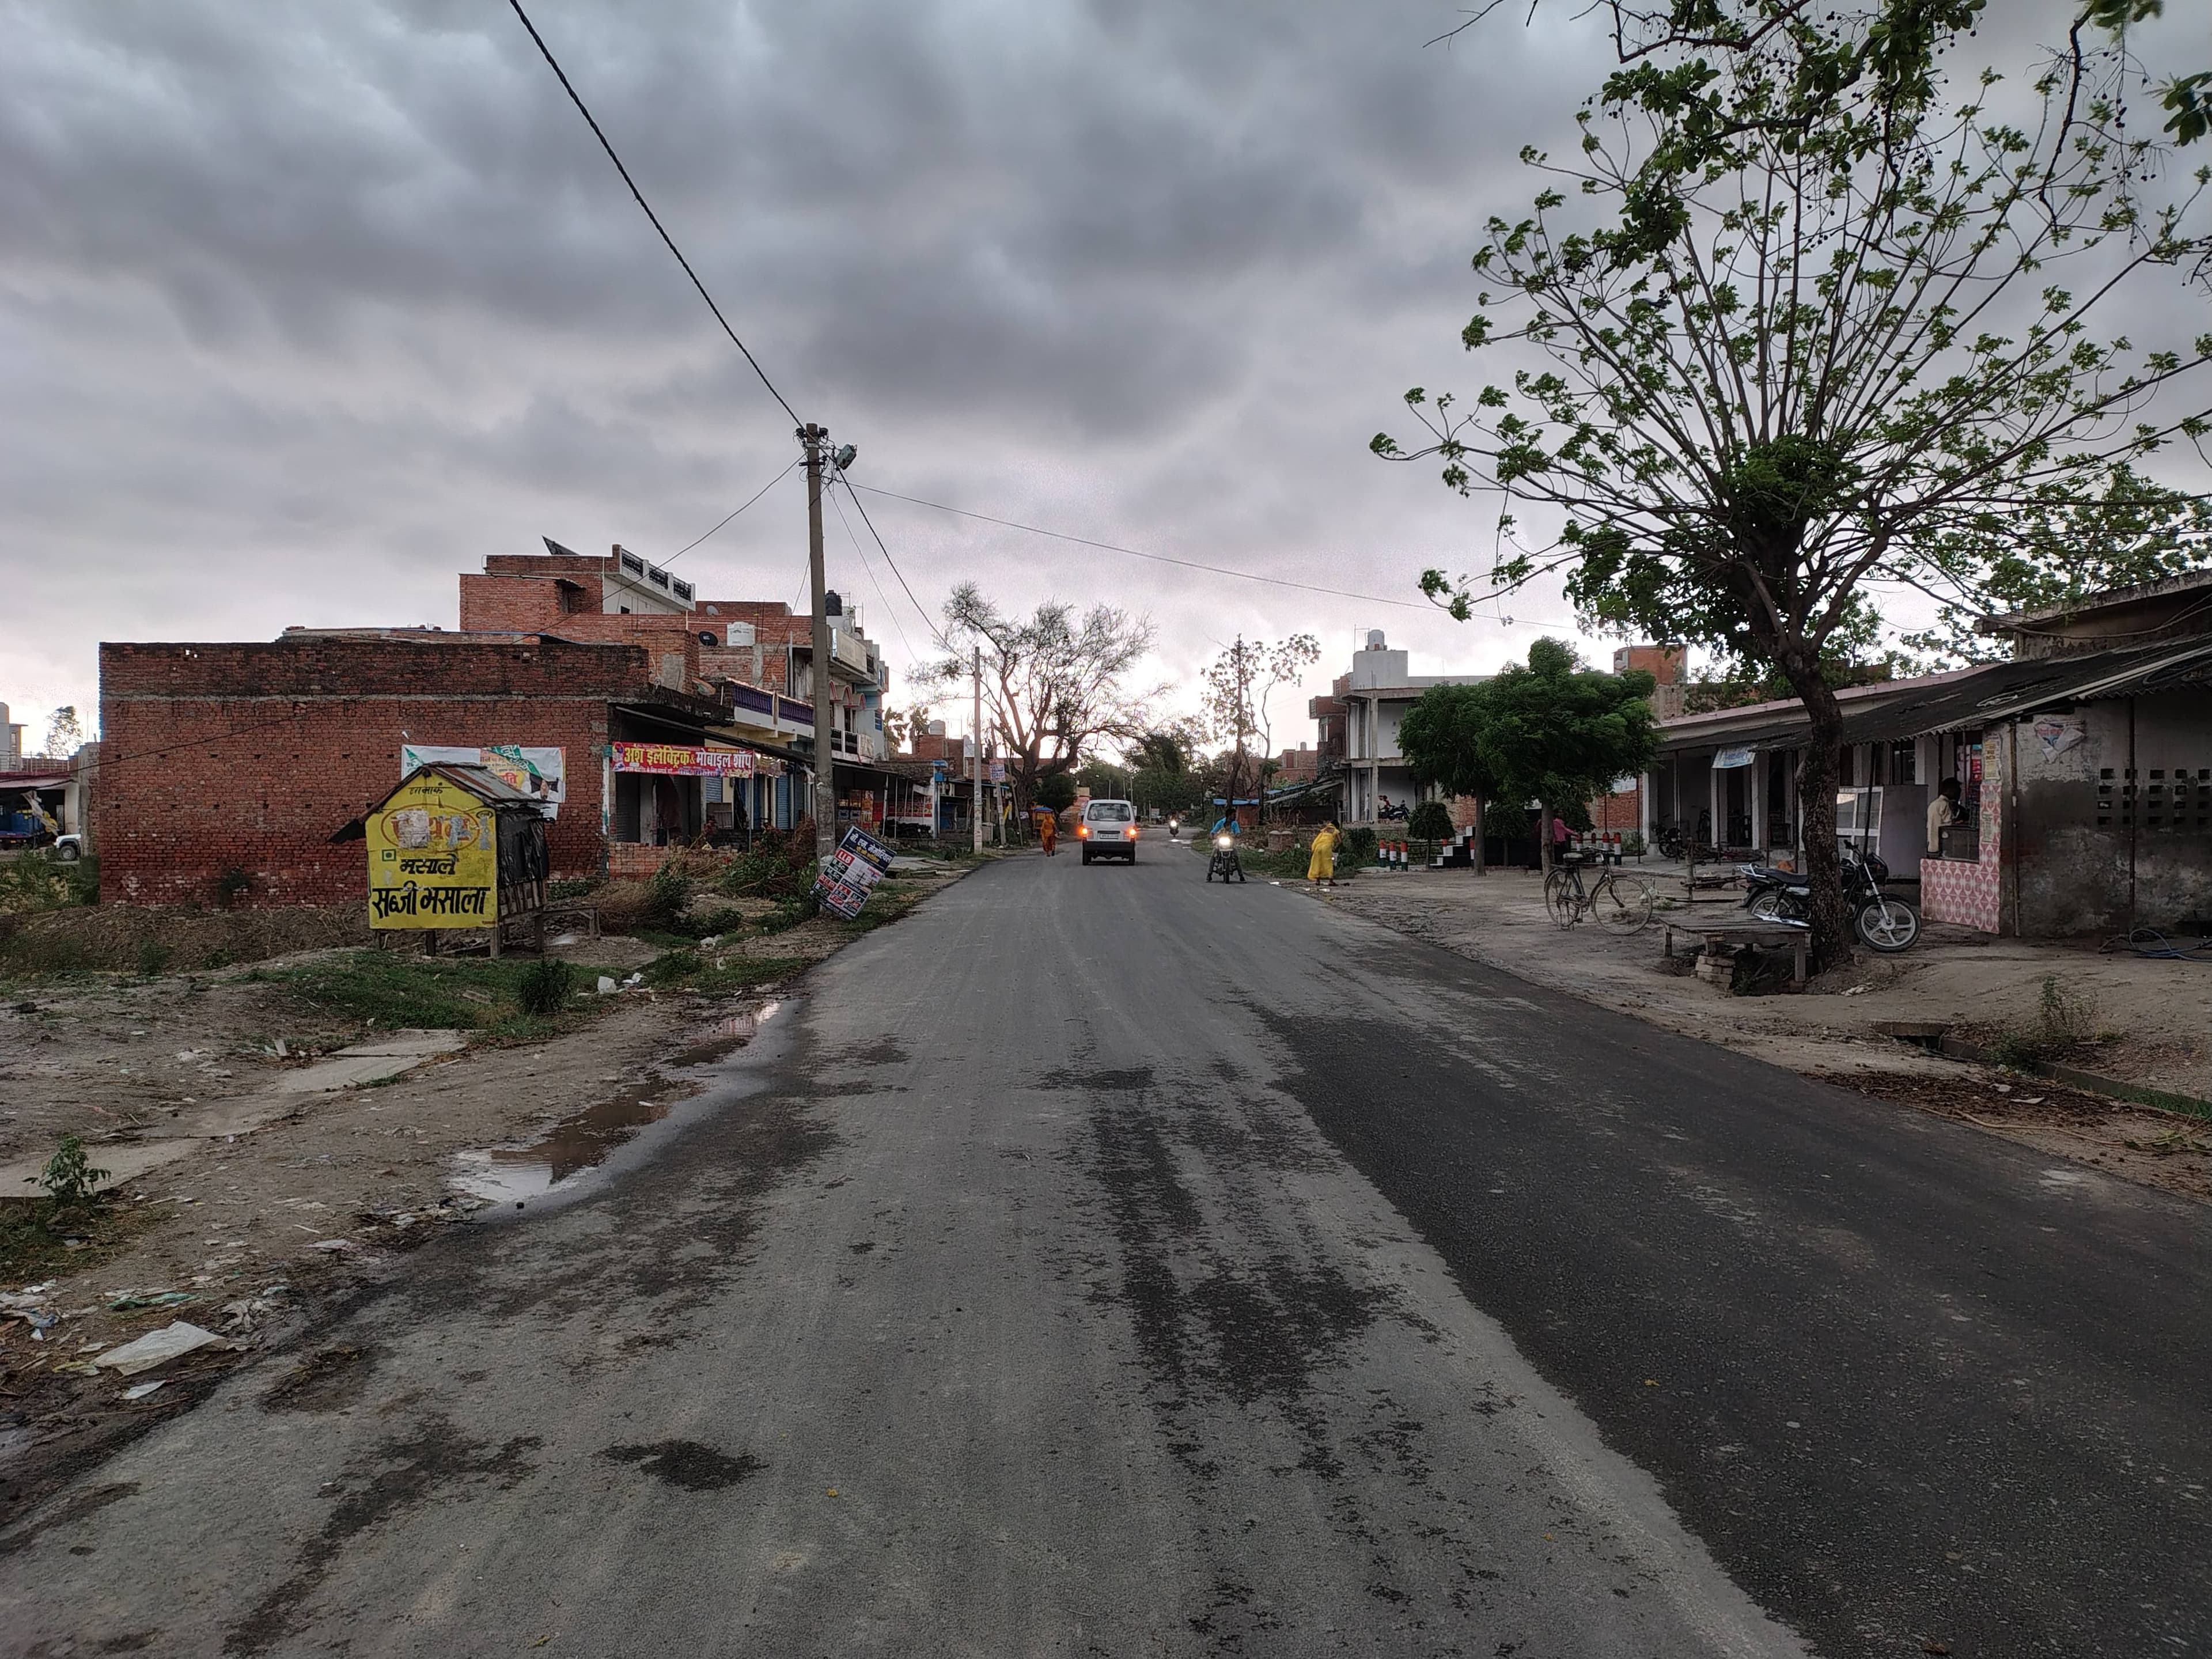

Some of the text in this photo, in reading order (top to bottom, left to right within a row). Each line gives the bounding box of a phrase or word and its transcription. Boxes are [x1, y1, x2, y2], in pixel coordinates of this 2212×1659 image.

[695, 747, 732, 770] मोबाइल
[400, 853, 459, 875] मसाले
[838, 851, 851, 864] LLB
